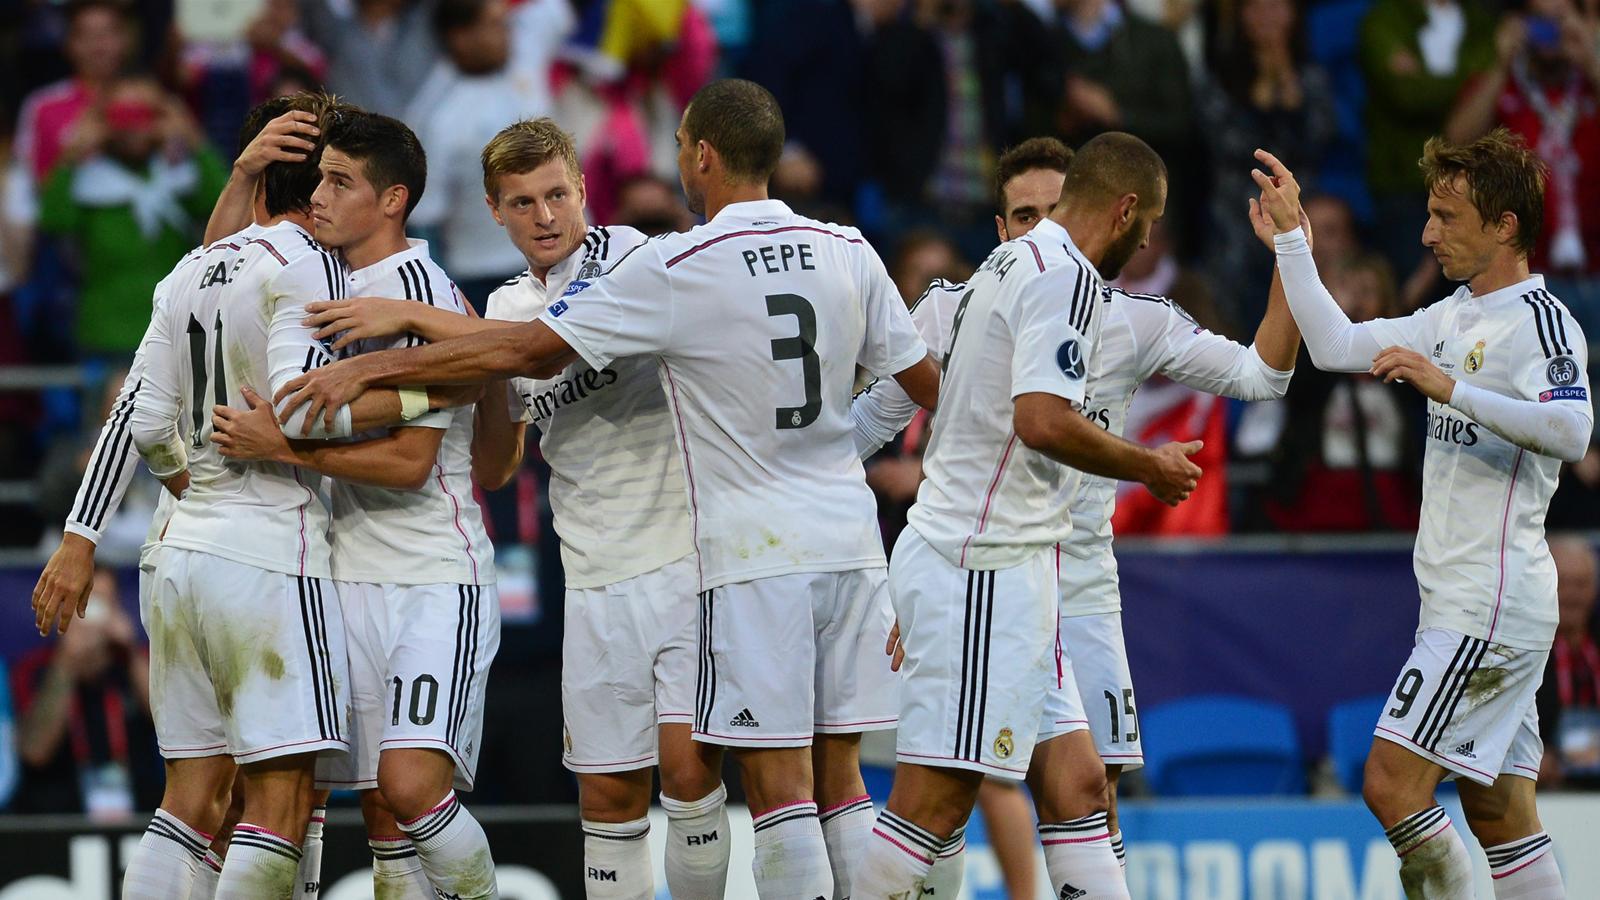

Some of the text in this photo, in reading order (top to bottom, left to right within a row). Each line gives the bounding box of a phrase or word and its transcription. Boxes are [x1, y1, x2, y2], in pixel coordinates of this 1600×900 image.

[199, 258, 246, 290] BAE
[742, 244, 816, 277] PEPE
[186, 308, 228, 449] 11
[765, 293, 823, 430] 3
[1556, 371, 1570, 382] 10
[521, 367, 618, 422] Emrates
[1553, 389, 1587, 398] RESPEC
[1427, 405, 1479, 447] irates
[391, 673, 440, 727] 10
[1389, 667, 1424, 719] 9
[729, 719, 760, 728] adidas
[1103, 688, 1139, 743] 15
[686, 830, 719, 846] RM
[587, 866, 618, 883] RM
